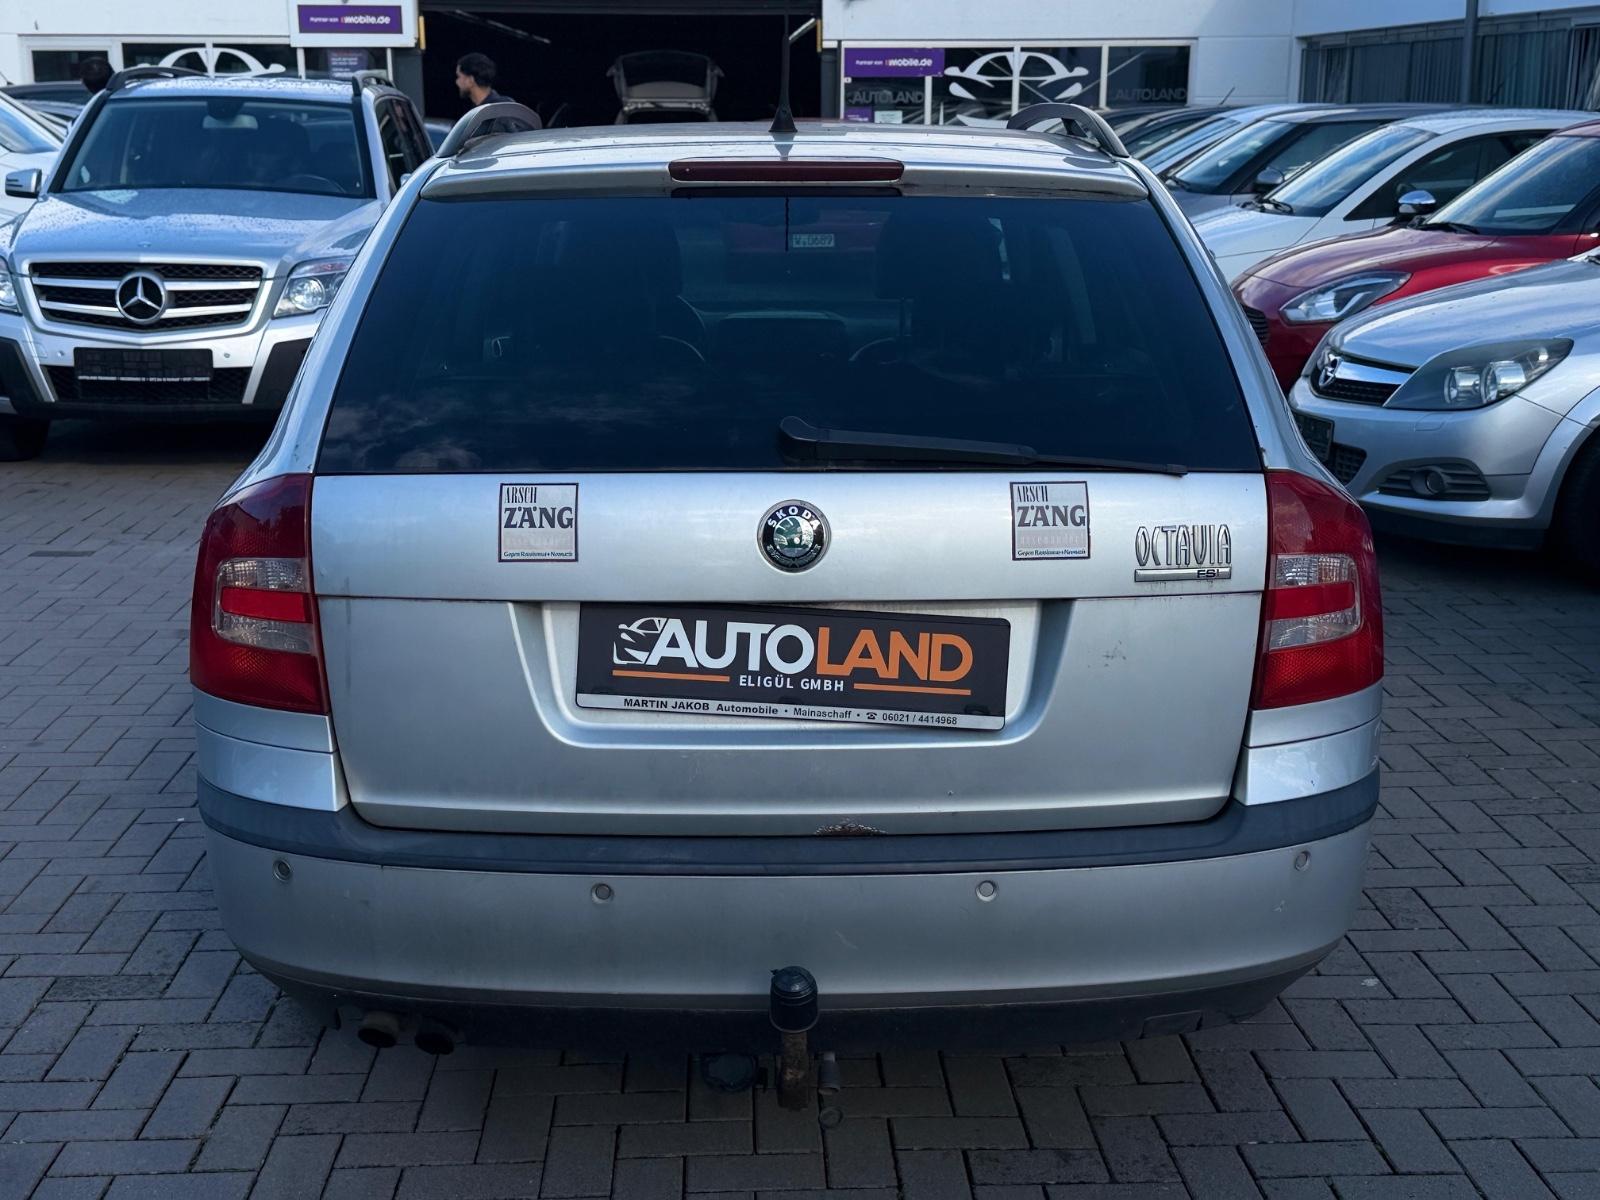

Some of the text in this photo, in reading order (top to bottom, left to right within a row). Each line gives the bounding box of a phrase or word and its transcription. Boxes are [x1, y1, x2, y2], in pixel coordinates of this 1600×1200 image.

[852, 90, 925, 104] AUTOLAND
[1115, 88, 1187, 101] AUTOLAND
[504, 486, 538, 504] ARSCH
[1016, 485, 1049, 502] ARSCH
[503, 506, 574, 529] ZÄNG
[1017, 504, 1086, 527] ZÄNG
[1135, 524, 1232, 567] OCTAVIA
[1197, 568, 1221, 579] FSI
[645, 618, 974, 683] AUTOLAND
[739, 674, 845, 692] ELIGÜL GMBH
[623, 697, 668, 709] MARTIN
[671, 700, 710, 711] JAKOB
[716, 702, 779, 715] Automobile
[793, 707, 852, 719] Mainaschaff
[882, 712, 910, 723] 06021
[918, 714, 958, 725] 4414968
